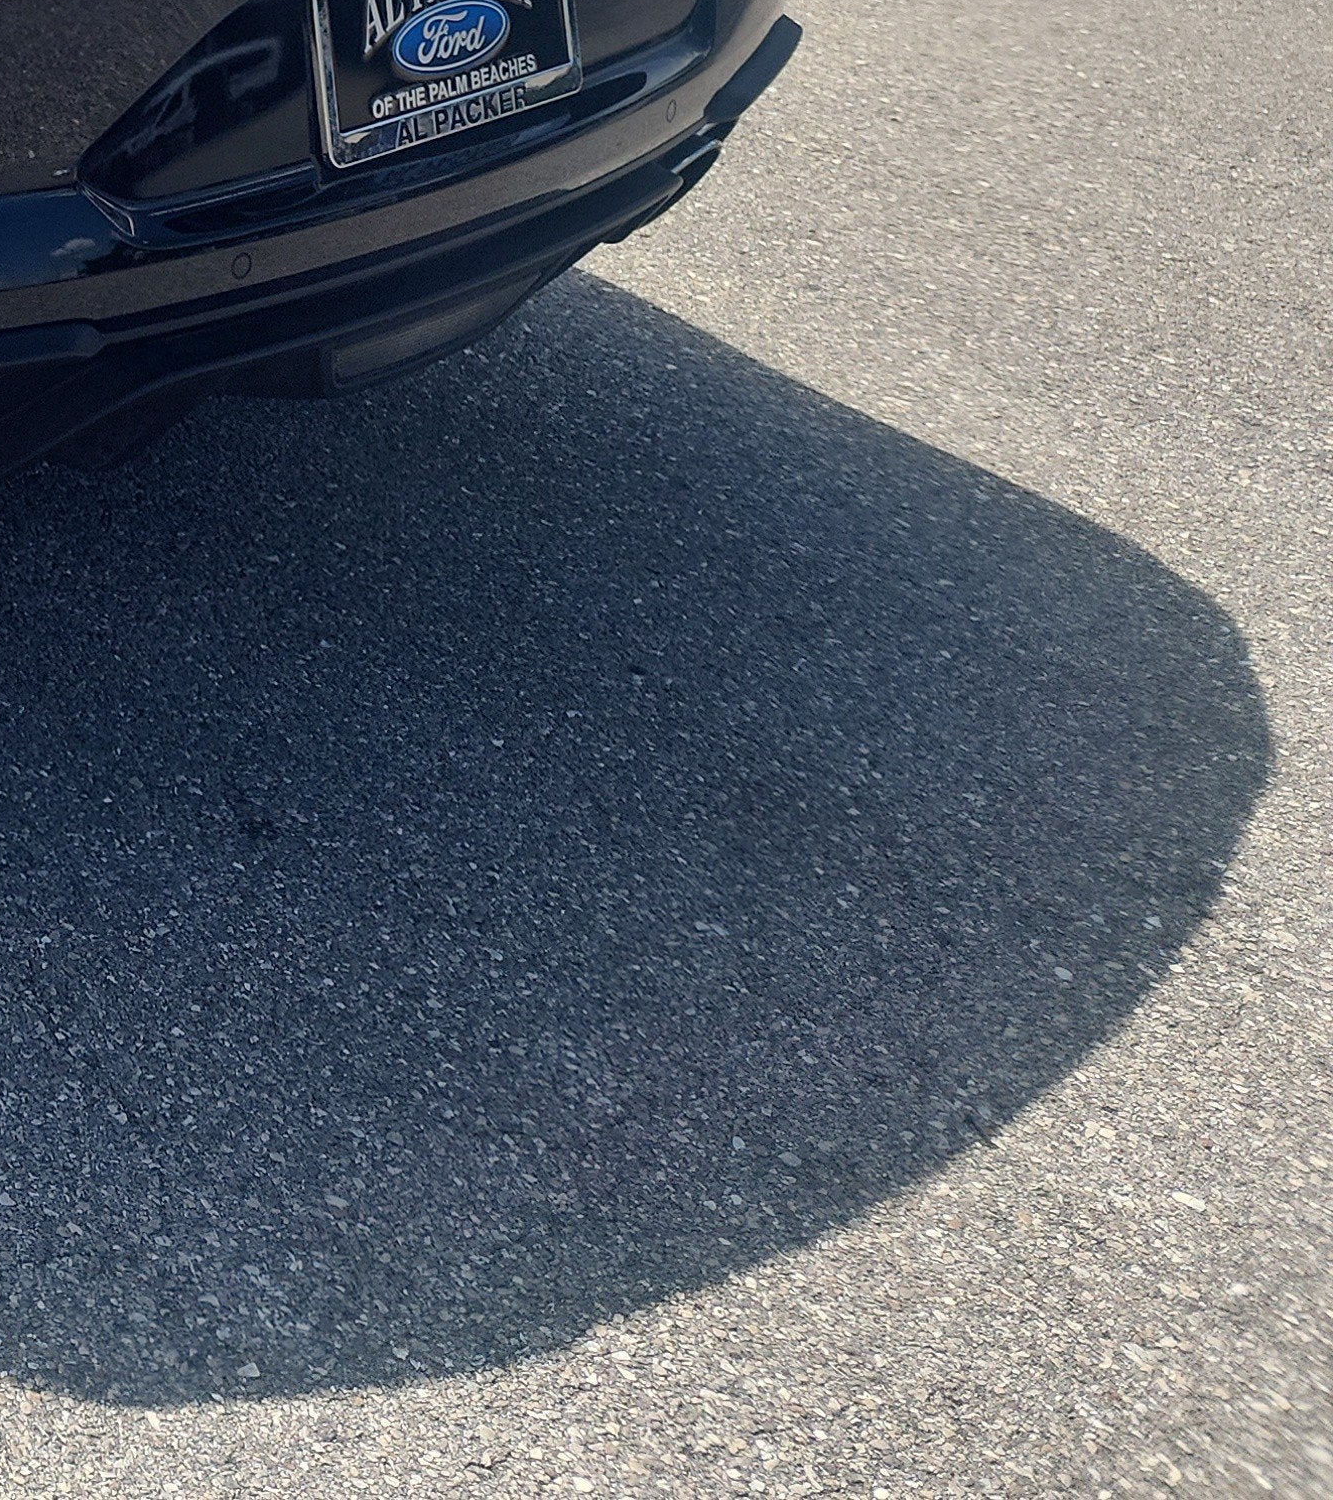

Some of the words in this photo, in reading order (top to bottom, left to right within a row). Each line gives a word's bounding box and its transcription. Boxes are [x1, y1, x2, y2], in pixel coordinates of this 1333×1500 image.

[418, 10, 485, 65] Ford
[371, 96, 395, 119] OF
[397, 86, 427, 110] THE
[429, 75, 469, 101] PALM
[470, 53, 538, 88] BEACHES
[397, 118, 428, 146] AL
[434, 83, 527, 136] PACKER
